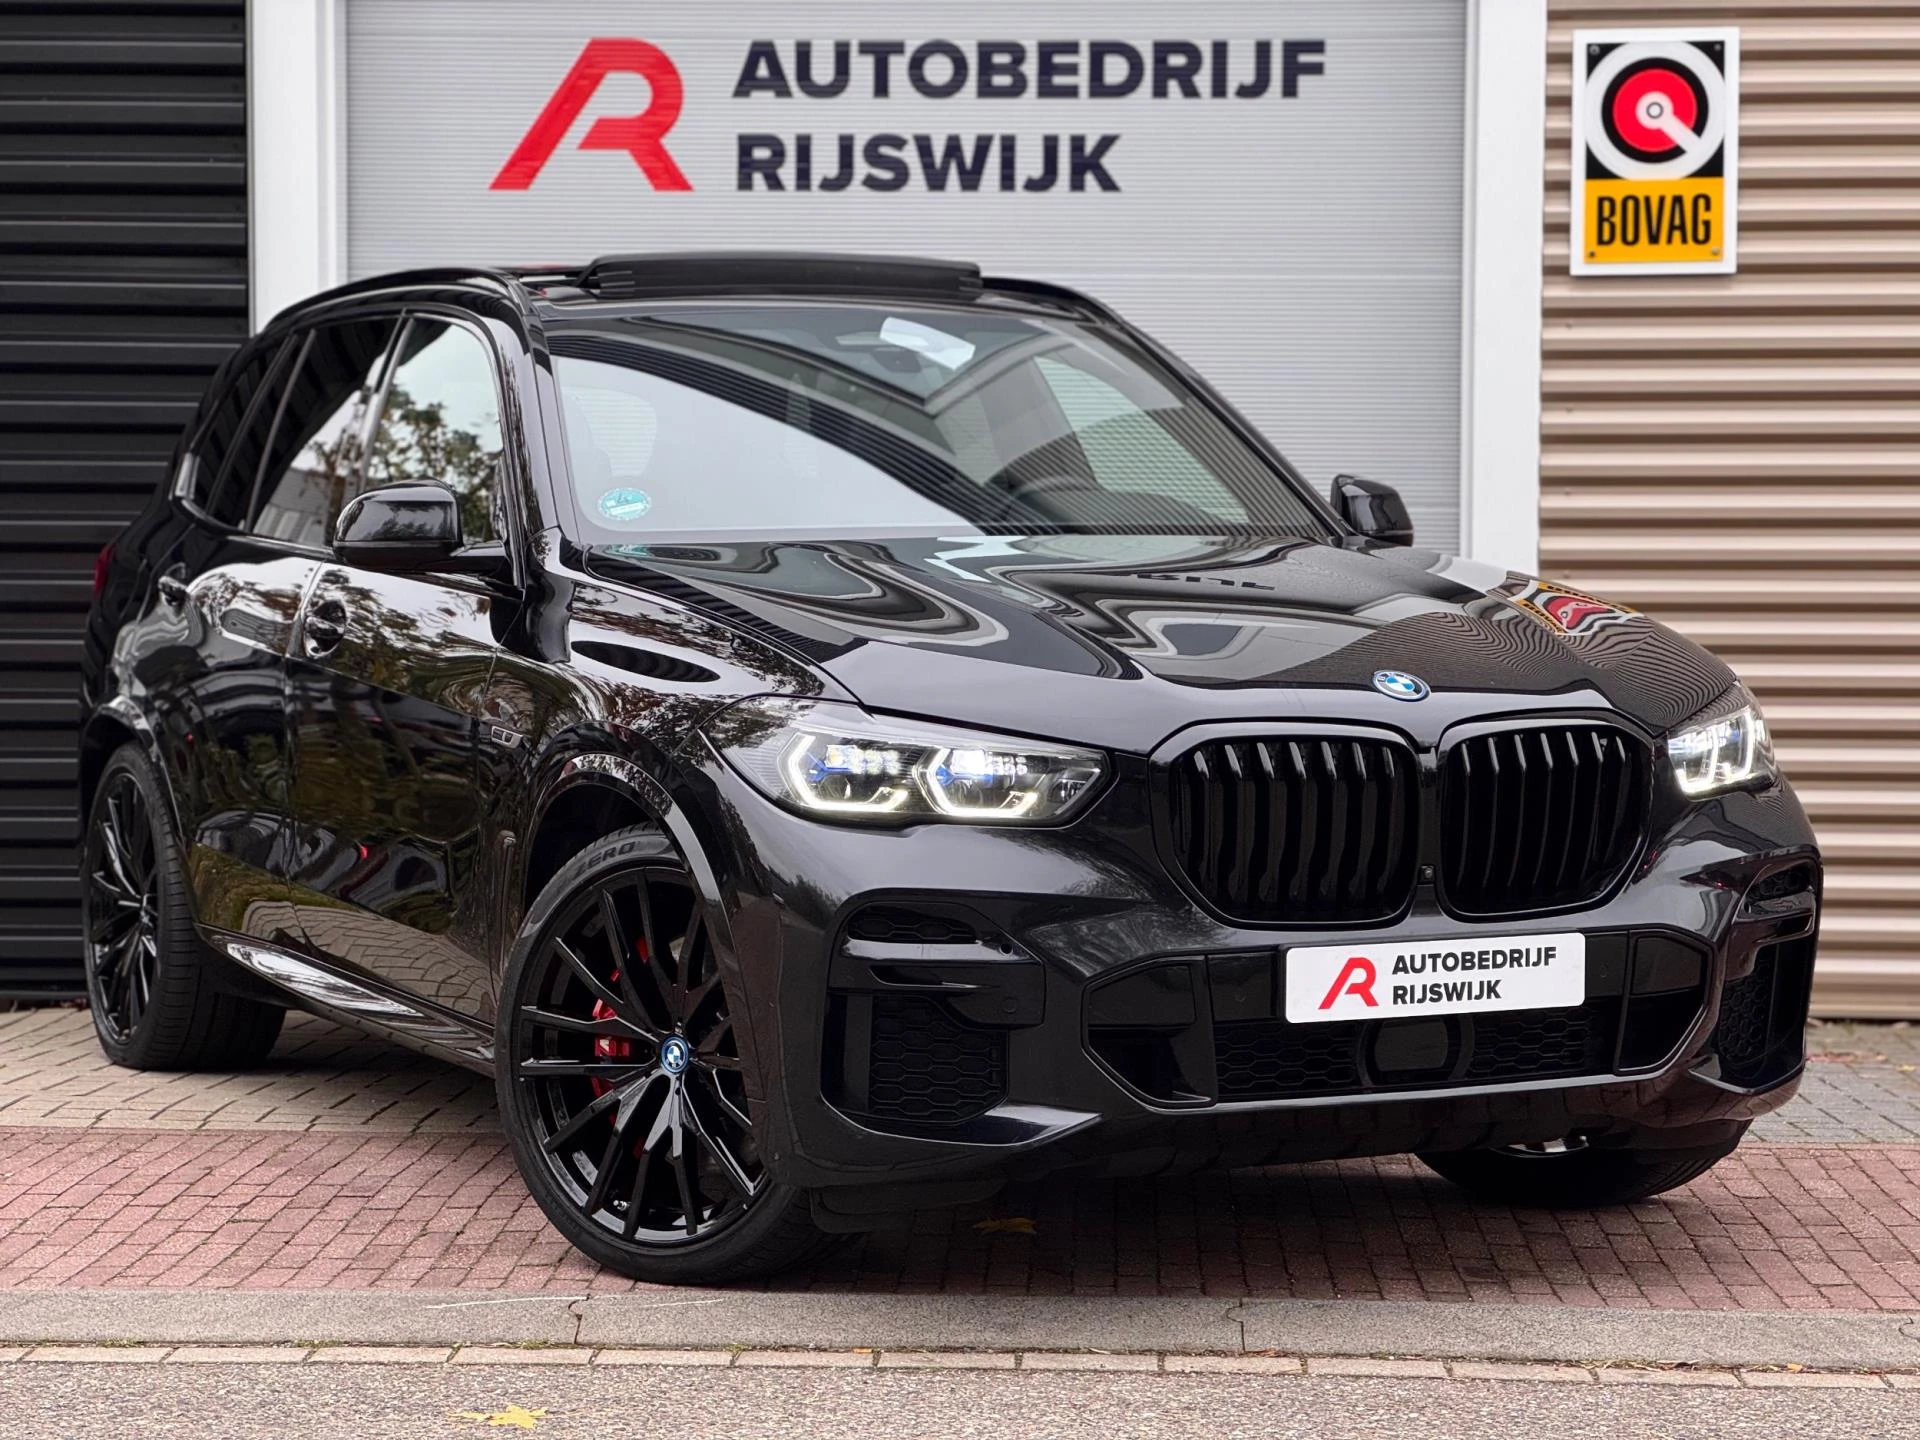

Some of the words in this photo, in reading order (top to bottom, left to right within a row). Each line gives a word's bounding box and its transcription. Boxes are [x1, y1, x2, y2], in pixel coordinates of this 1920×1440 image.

[733, 40, 1325, 98] AUTOBEDRIJF
[736, 134, 1121, 192] RIJSWIJK
[1597, 194, 1711, 246] BOVAG
[1392, 946, 1557, 975] AUTOBEDRIJF
[1392, 979, 1502, 1005] RIJSWIJK
